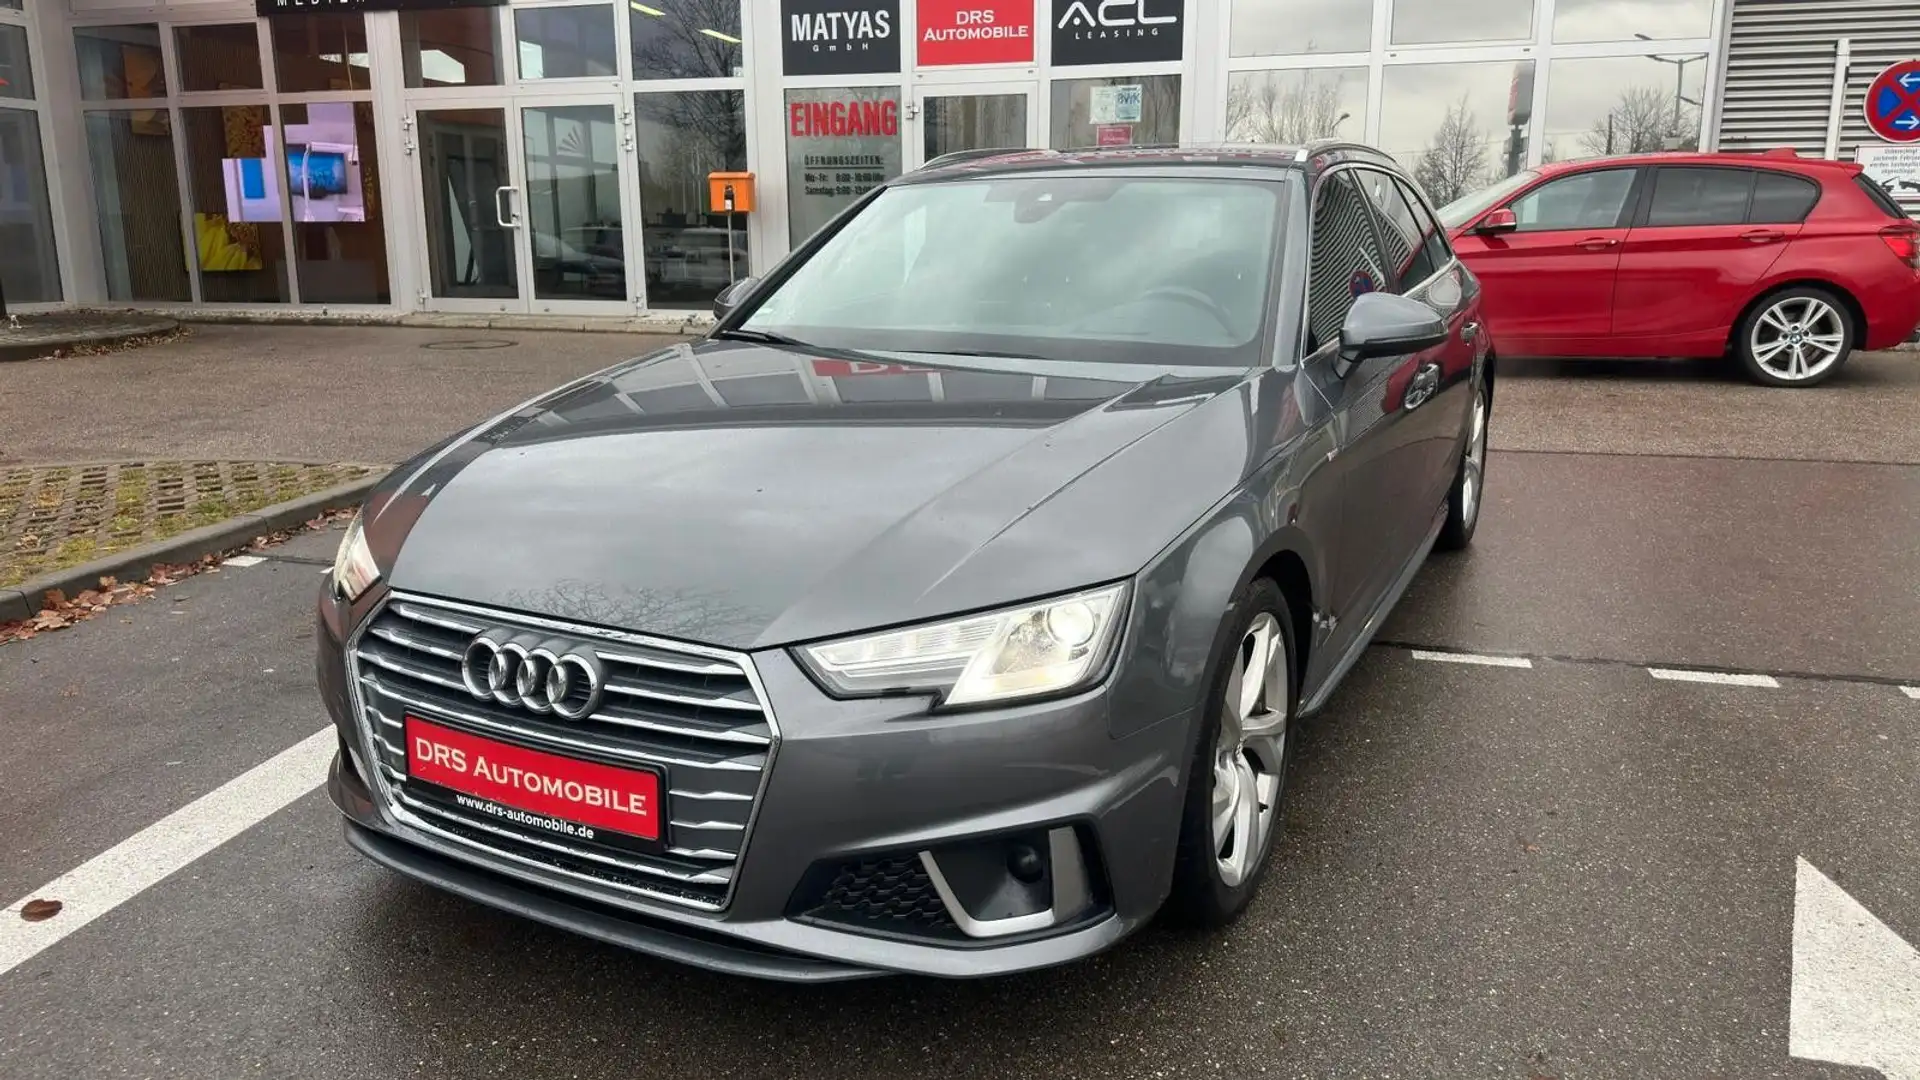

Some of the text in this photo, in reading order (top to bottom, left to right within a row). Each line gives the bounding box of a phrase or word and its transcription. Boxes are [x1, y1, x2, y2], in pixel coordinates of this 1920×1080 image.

[791, 9, 891, 42] MATYAS
[956, 9, 994, 25] DRS
[1058, 0, 1177, 29] ACL
[924, 25, 1029, 42] AUTOMOBILE
[1075, 28, 1159, 40] LEASING
[790, 100, 898, 137] EINGANG
[415, 737, 648, 817] DRS AUTOMOBILE
[456, 793, 595, 840] www.drs-automobile.de
